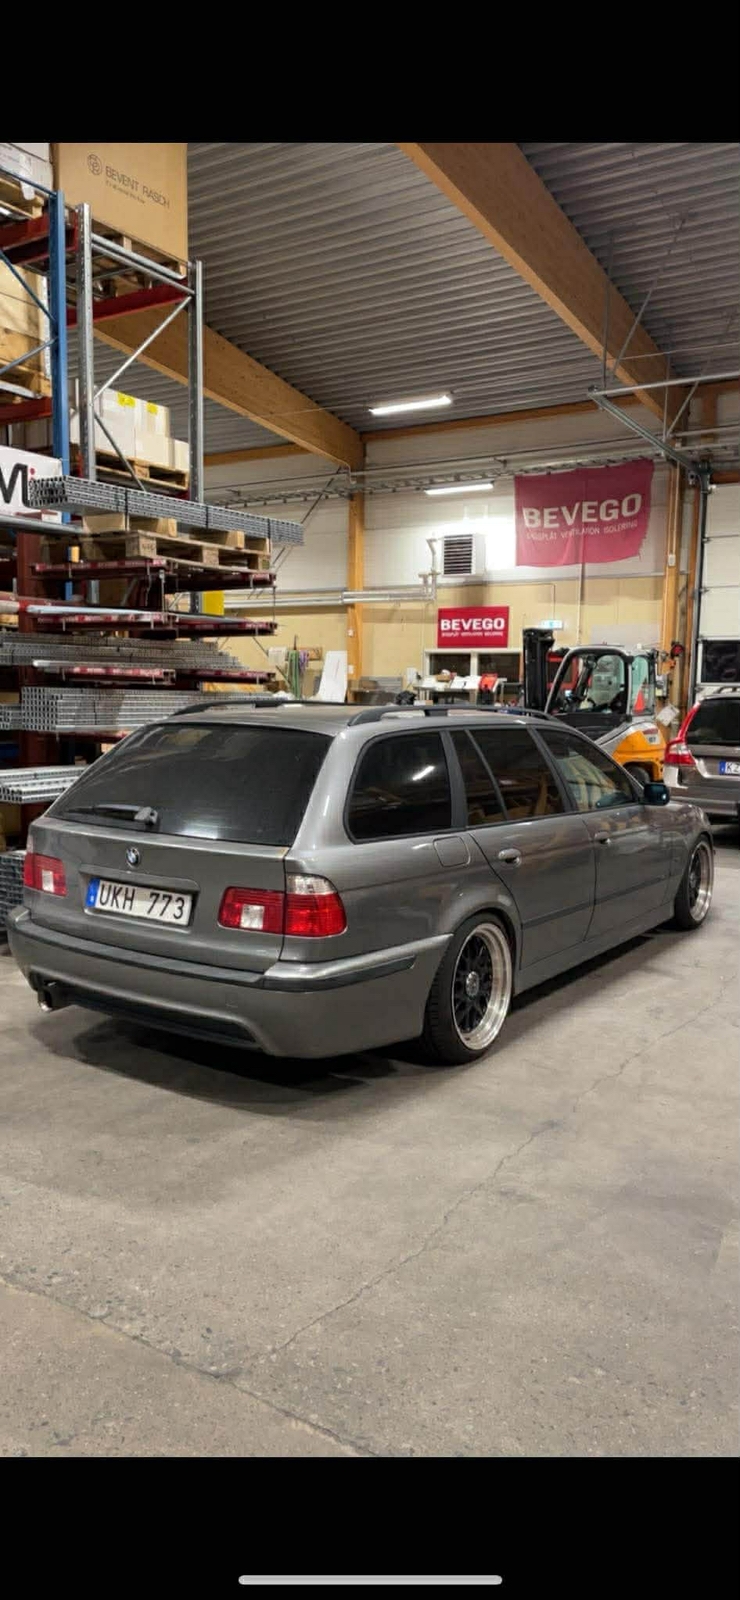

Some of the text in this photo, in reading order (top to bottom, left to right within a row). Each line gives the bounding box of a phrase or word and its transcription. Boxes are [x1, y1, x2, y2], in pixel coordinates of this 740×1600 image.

[105, 165, 139, 192] BEVENT
[142, 185, 169, 208] RASCH
[522, 493, 642, 528] BEVEGO
[440, 617, 505, 631] BEVEGO
[99, 884, 185, 919] UKH 773
